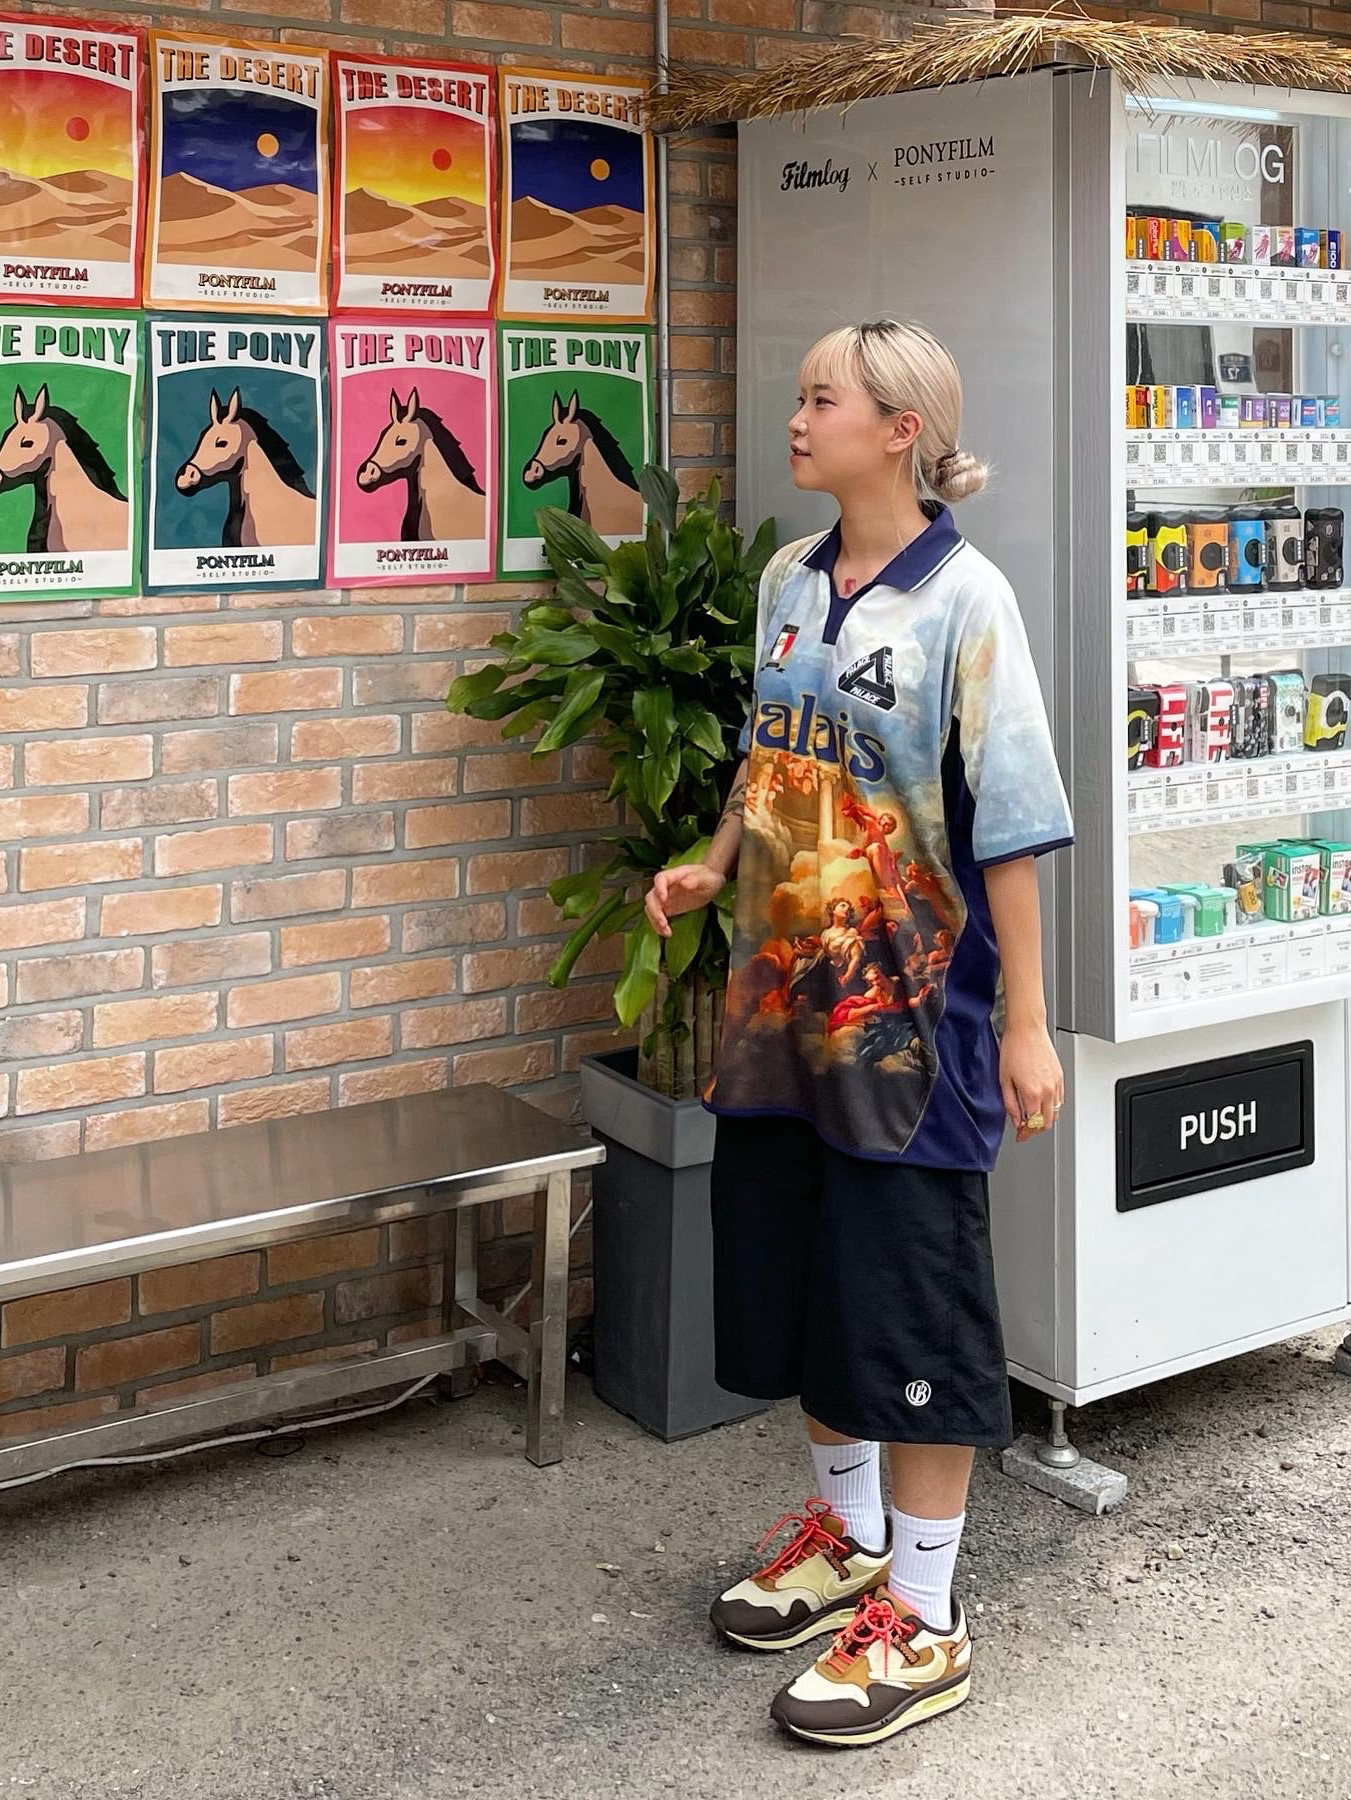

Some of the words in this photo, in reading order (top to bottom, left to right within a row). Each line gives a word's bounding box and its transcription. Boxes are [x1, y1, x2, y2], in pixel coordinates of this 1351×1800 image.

[25, 33, 133, 80] DESERT
[160, 47, 210, 82] THE
[219, 54, 319, 99] DESERT
[341, 68, 389, 101] THE
[396, 73, 486, 115] DESERT
[508, 82, 550, 115] THE
[556, 87, 643, 126] DESERT
[894, 136, 995, 167] PONYFILM
[781, 158, 850, 193] Filmlog
[3, 264, 88, 281] PONYFILM
[198, 273, 276, 291] PONYFILM
[381, 282, 452, 298] PONYFILM
[543, 287, 609, 302] PONYFILM
[35, 325, 131, 365] PONY
[157, 329, 216, 367] THE
[228, 330, 316, 369] PONY
[341, 332, 394, 368] THE
[405, 334, 484, 370] PONY
[508, 337, 557, 371] THE
[567, 338, 641, 374] PONY
[0, 560, 84, 576] PONYFILM
[196, 554, 275, 570] PONYFILM
[376, 548, 449, 563] PONYFILM
[845, 654, 872, 679] PALACE
[883, 653, 893, 686] PALACE
[849, 685, 882, 706] PALACE
[752, 694, 886, 783] alais
[1161, 692, 1187, 766] LIFE
[1209, 689, 1233, 763] LIFE
[1180, 1100, 1257, 1150] PUSH
